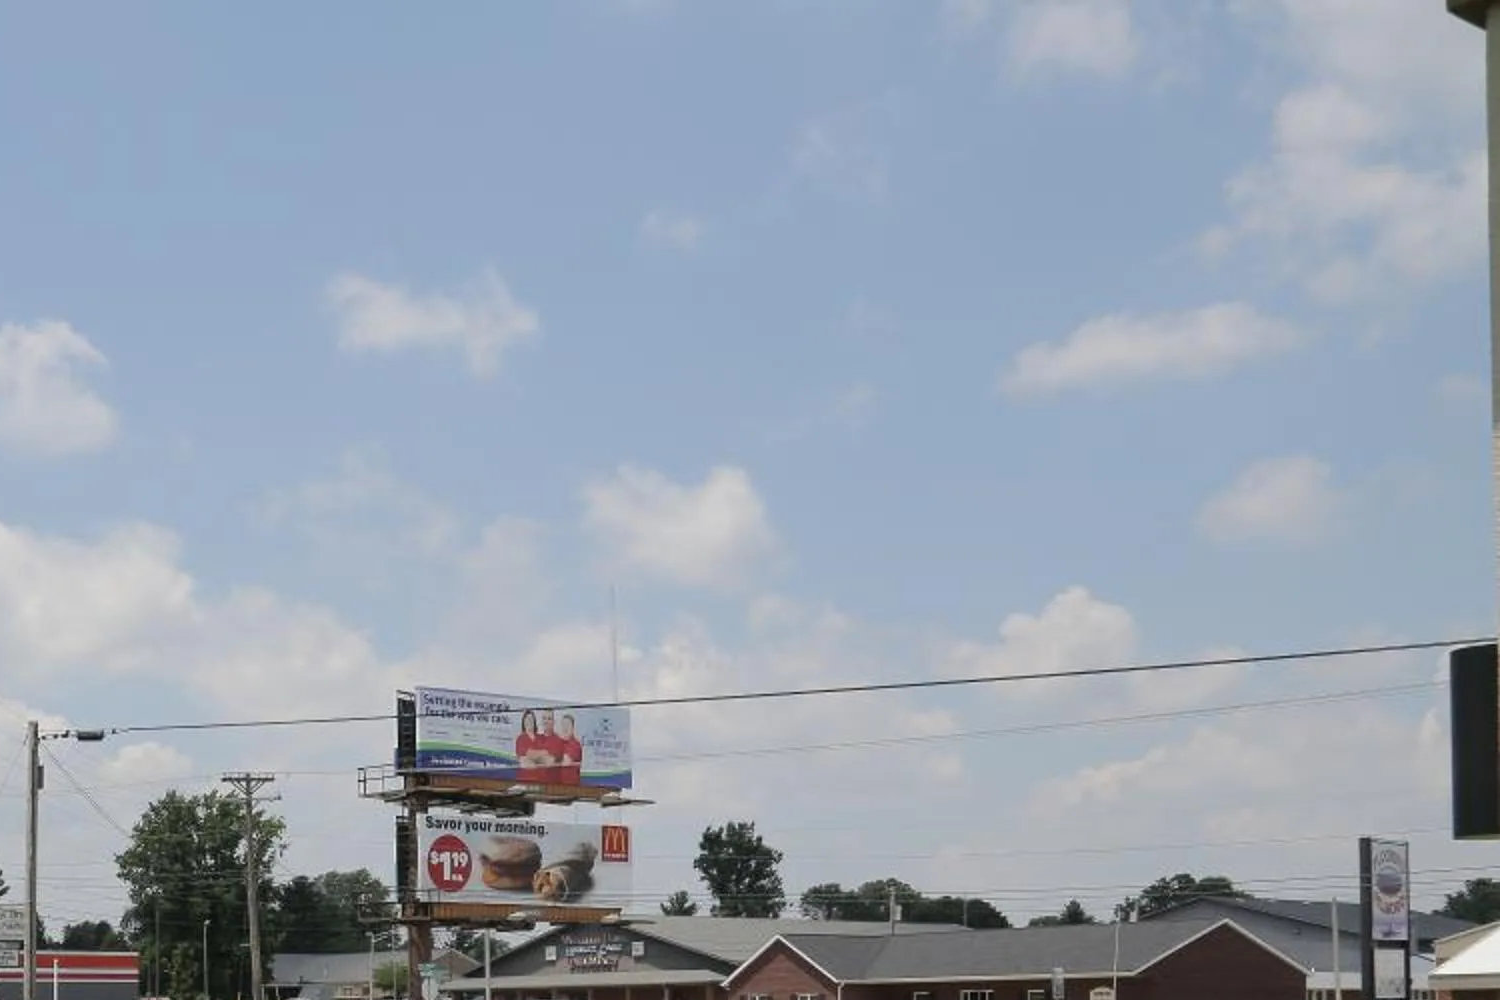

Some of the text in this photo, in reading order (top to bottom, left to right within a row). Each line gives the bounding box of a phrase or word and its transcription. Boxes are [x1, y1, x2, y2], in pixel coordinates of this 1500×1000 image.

[425, 815, 549, 838] Savor your morning.
